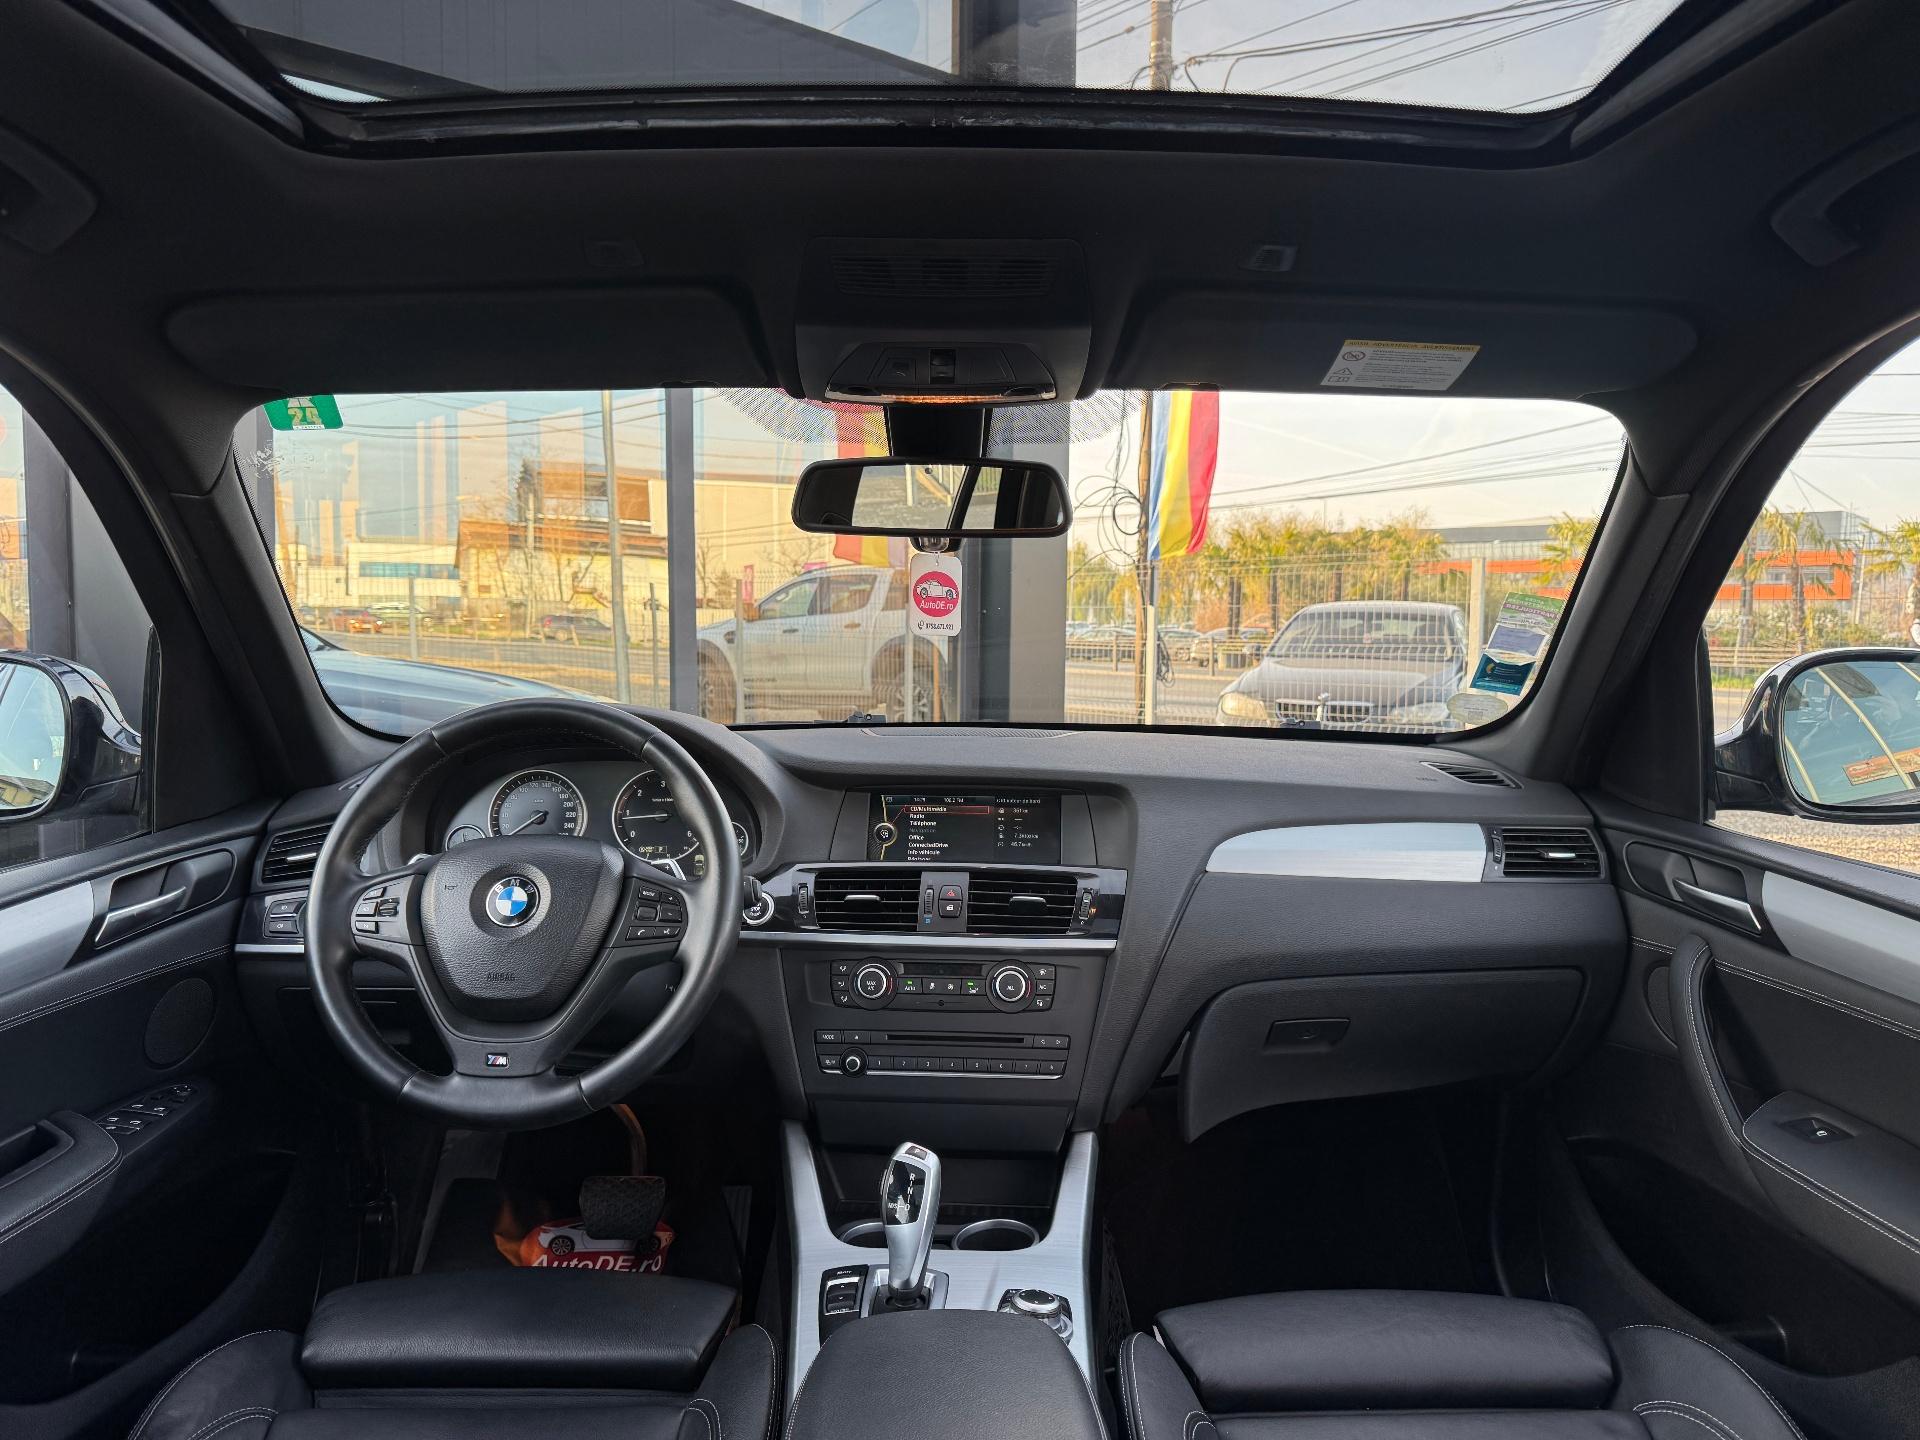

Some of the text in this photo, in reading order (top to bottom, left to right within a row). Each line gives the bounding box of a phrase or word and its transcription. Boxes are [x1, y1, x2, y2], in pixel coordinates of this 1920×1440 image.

[919, 600, 954, 610] AutoDE.ro
[494, 879, 534, 893] BMW
[910, 1172, 916, 1180] R
